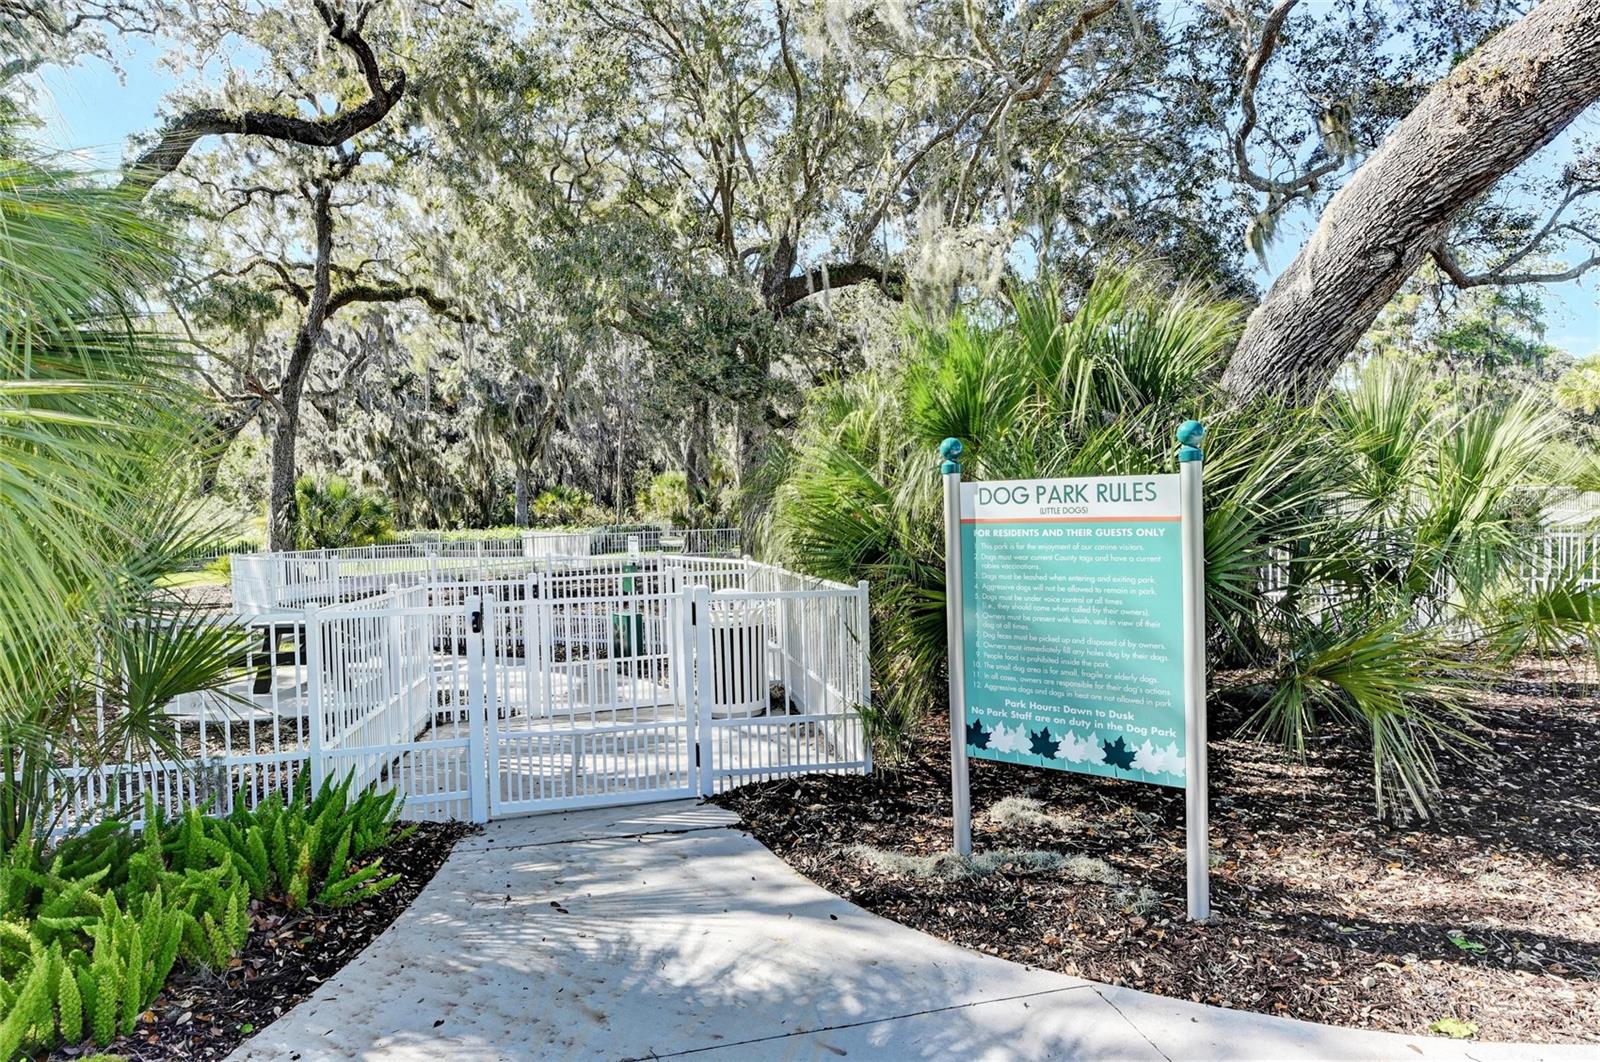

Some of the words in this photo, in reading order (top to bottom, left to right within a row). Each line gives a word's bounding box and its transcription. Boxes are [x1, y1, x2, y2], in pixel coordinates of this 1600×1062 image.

[979, 486, 1029, 505] DOG
[1036, 484, 1089, 504] PARK
[1097, 482, 1157, 502] RULES
[974, 529, 990, 537] FOR
[993, 529, 1039, 537] RESIDENTS
[1042, 529, 1064, 537] AND
[1067, 529, 1092, 537] THEIR
[1096, 528, 1133, 537] GUESTS
[1136, 528, 1165, 537] ONLY
[1005, 699, 1026, 708] Park
[1030, 702, 1061, 711] Hours:
[1064, 705, 1092, 715] Dawn
[1109, 710, 1135, 720] Dusk
[987, 708, 1008, 717] Park
[1011, 711, 1032, 720] Staff
[1069, 717, 1090, 729] duty
[1094, 720, 1103, 728] in
[1107, 722, 1123, 730] the
[1127, 724, 1147, 736] Dog
[1151, 728, 1176, 737] Park
